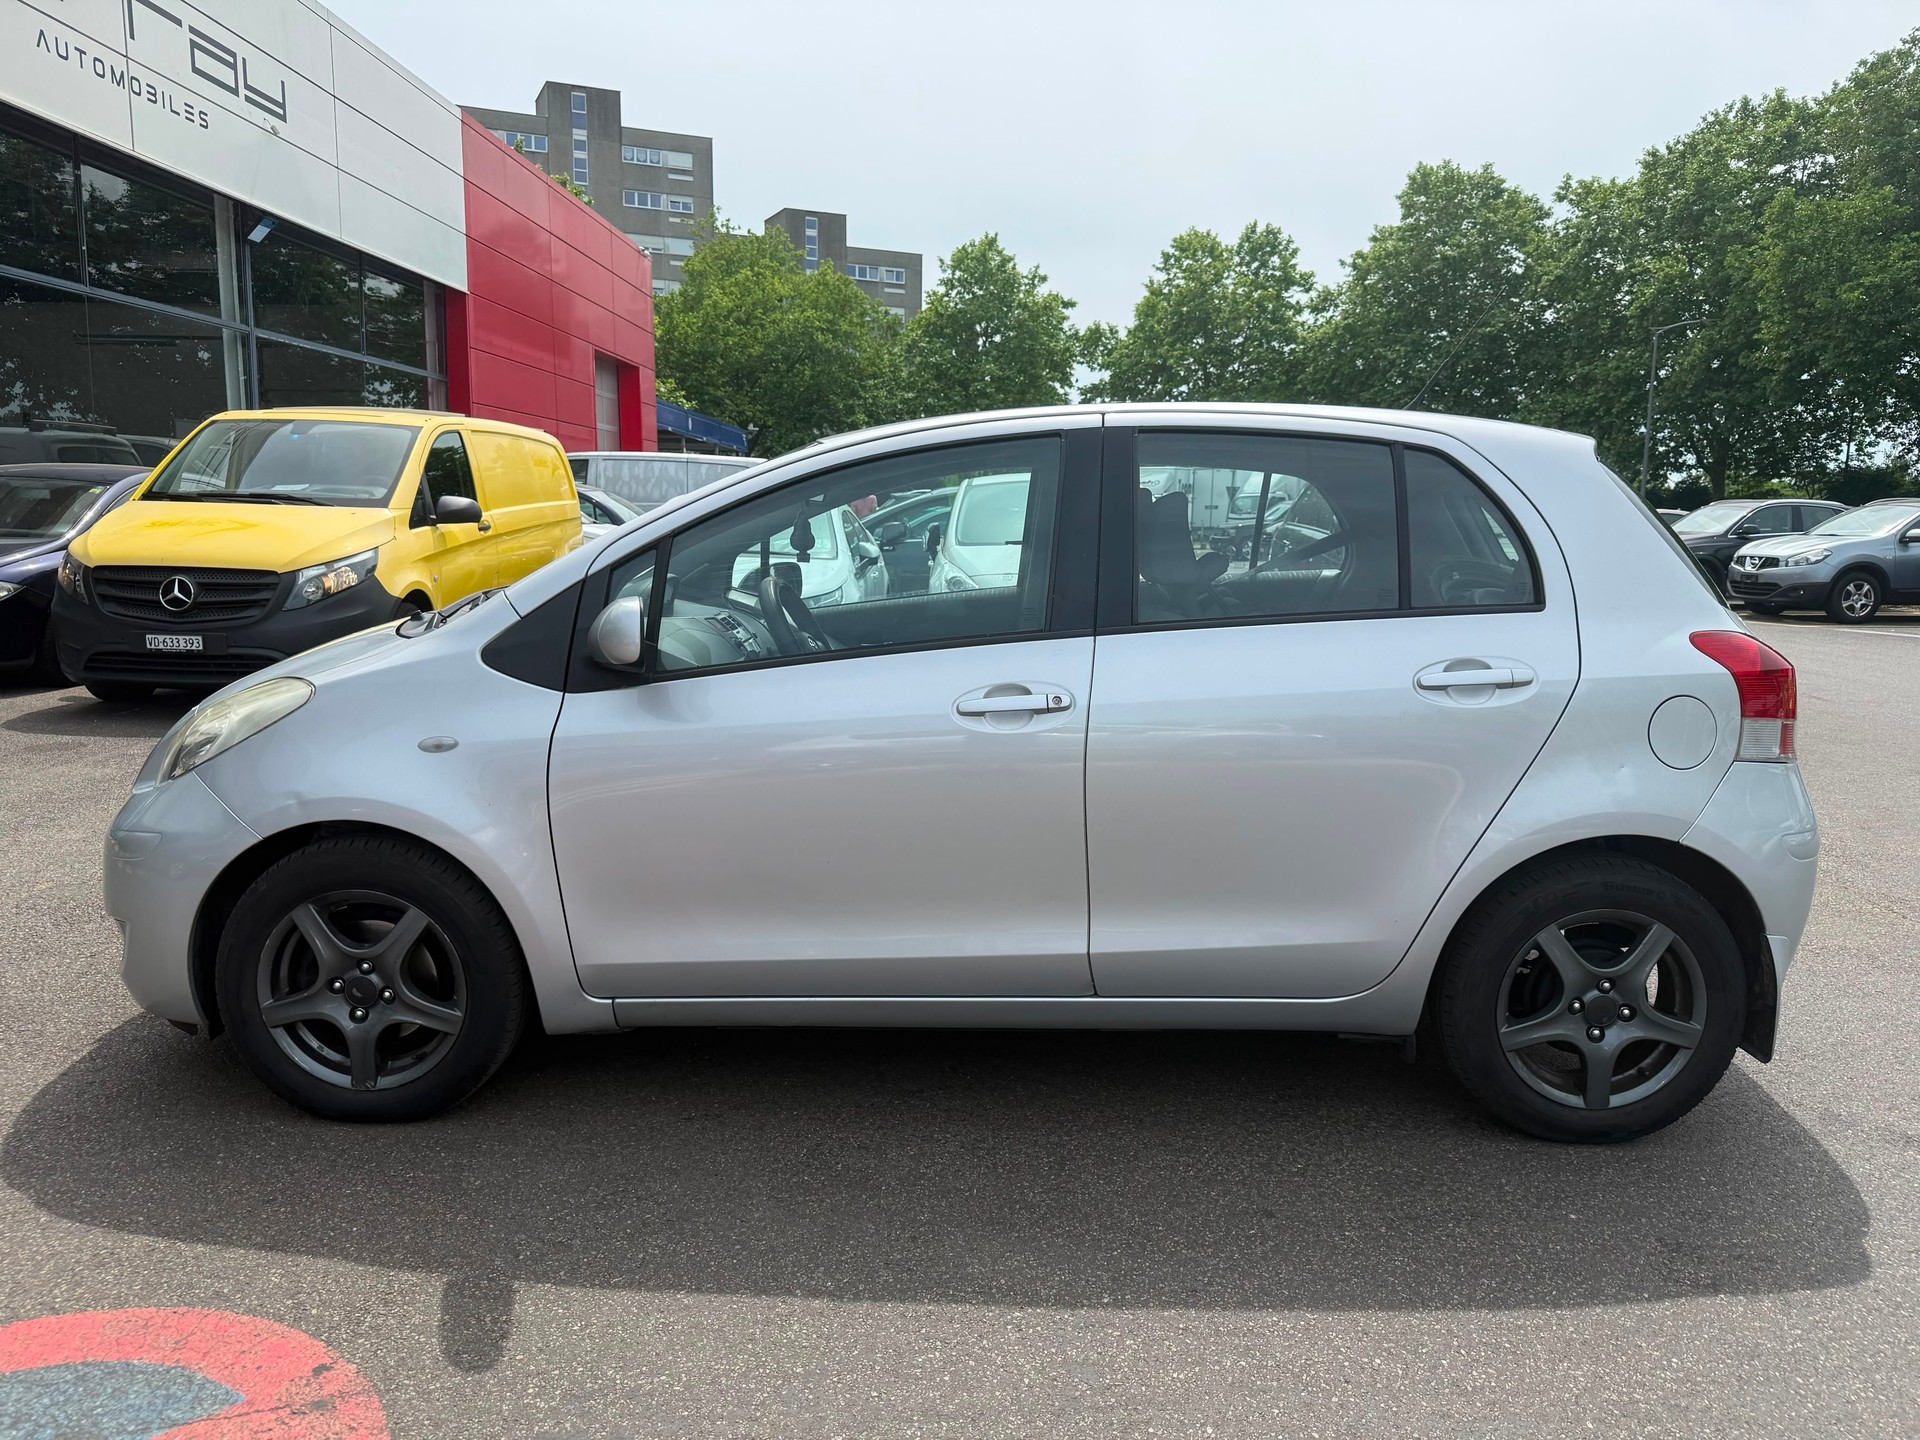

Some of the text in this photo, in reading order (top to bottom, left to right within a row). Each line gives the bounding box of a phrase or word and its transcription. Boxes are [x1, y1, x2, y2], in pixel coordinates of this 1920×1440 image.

[36, 28, 209, 130] AUTOMOBILES
[58, 0, 288, 124] ray
[182, 637, 201, 649] 393
